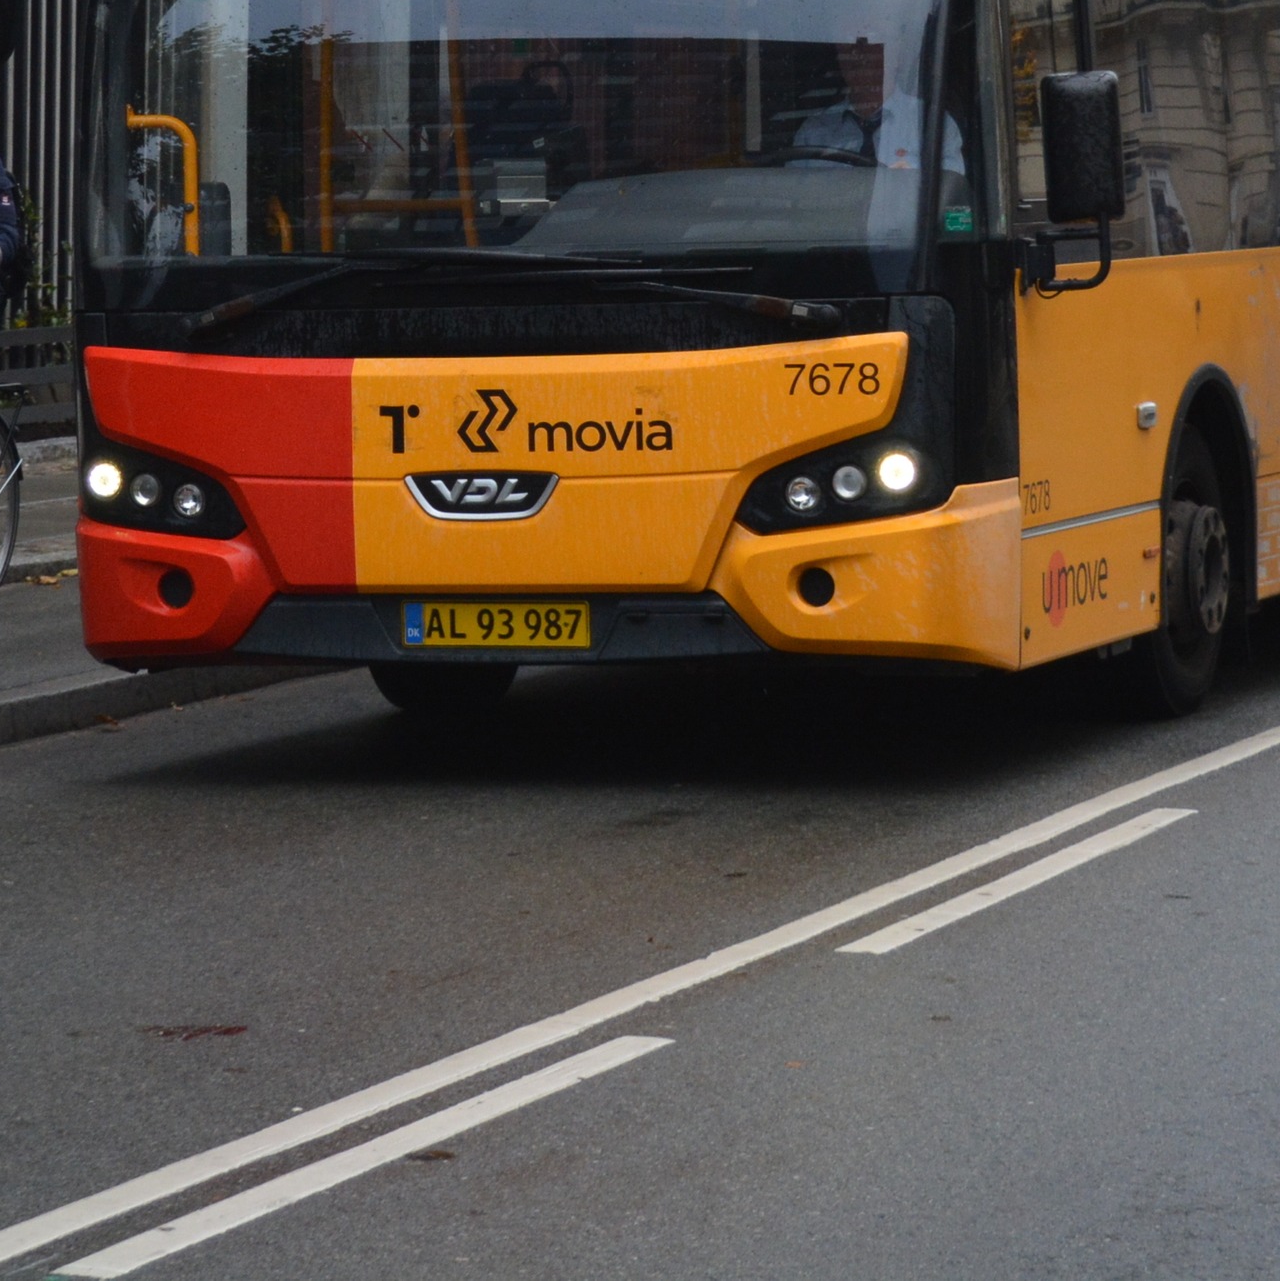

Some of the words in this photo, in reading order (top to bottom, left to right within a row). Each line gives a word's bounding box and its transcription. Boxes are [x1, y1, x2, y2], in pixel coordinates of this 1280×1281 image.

[783, 362, 881, 396] 7678
[528, 407, 674, 453] movia
[429, 477, 530, 505] VDL
[1022, 479, 1052, 516] 7678
[407, 627, 421, 638] DK
[425, 608, 467, 639] AL
[476, 608, 515, 640] 93
[523, 608, 583, 641] 987
